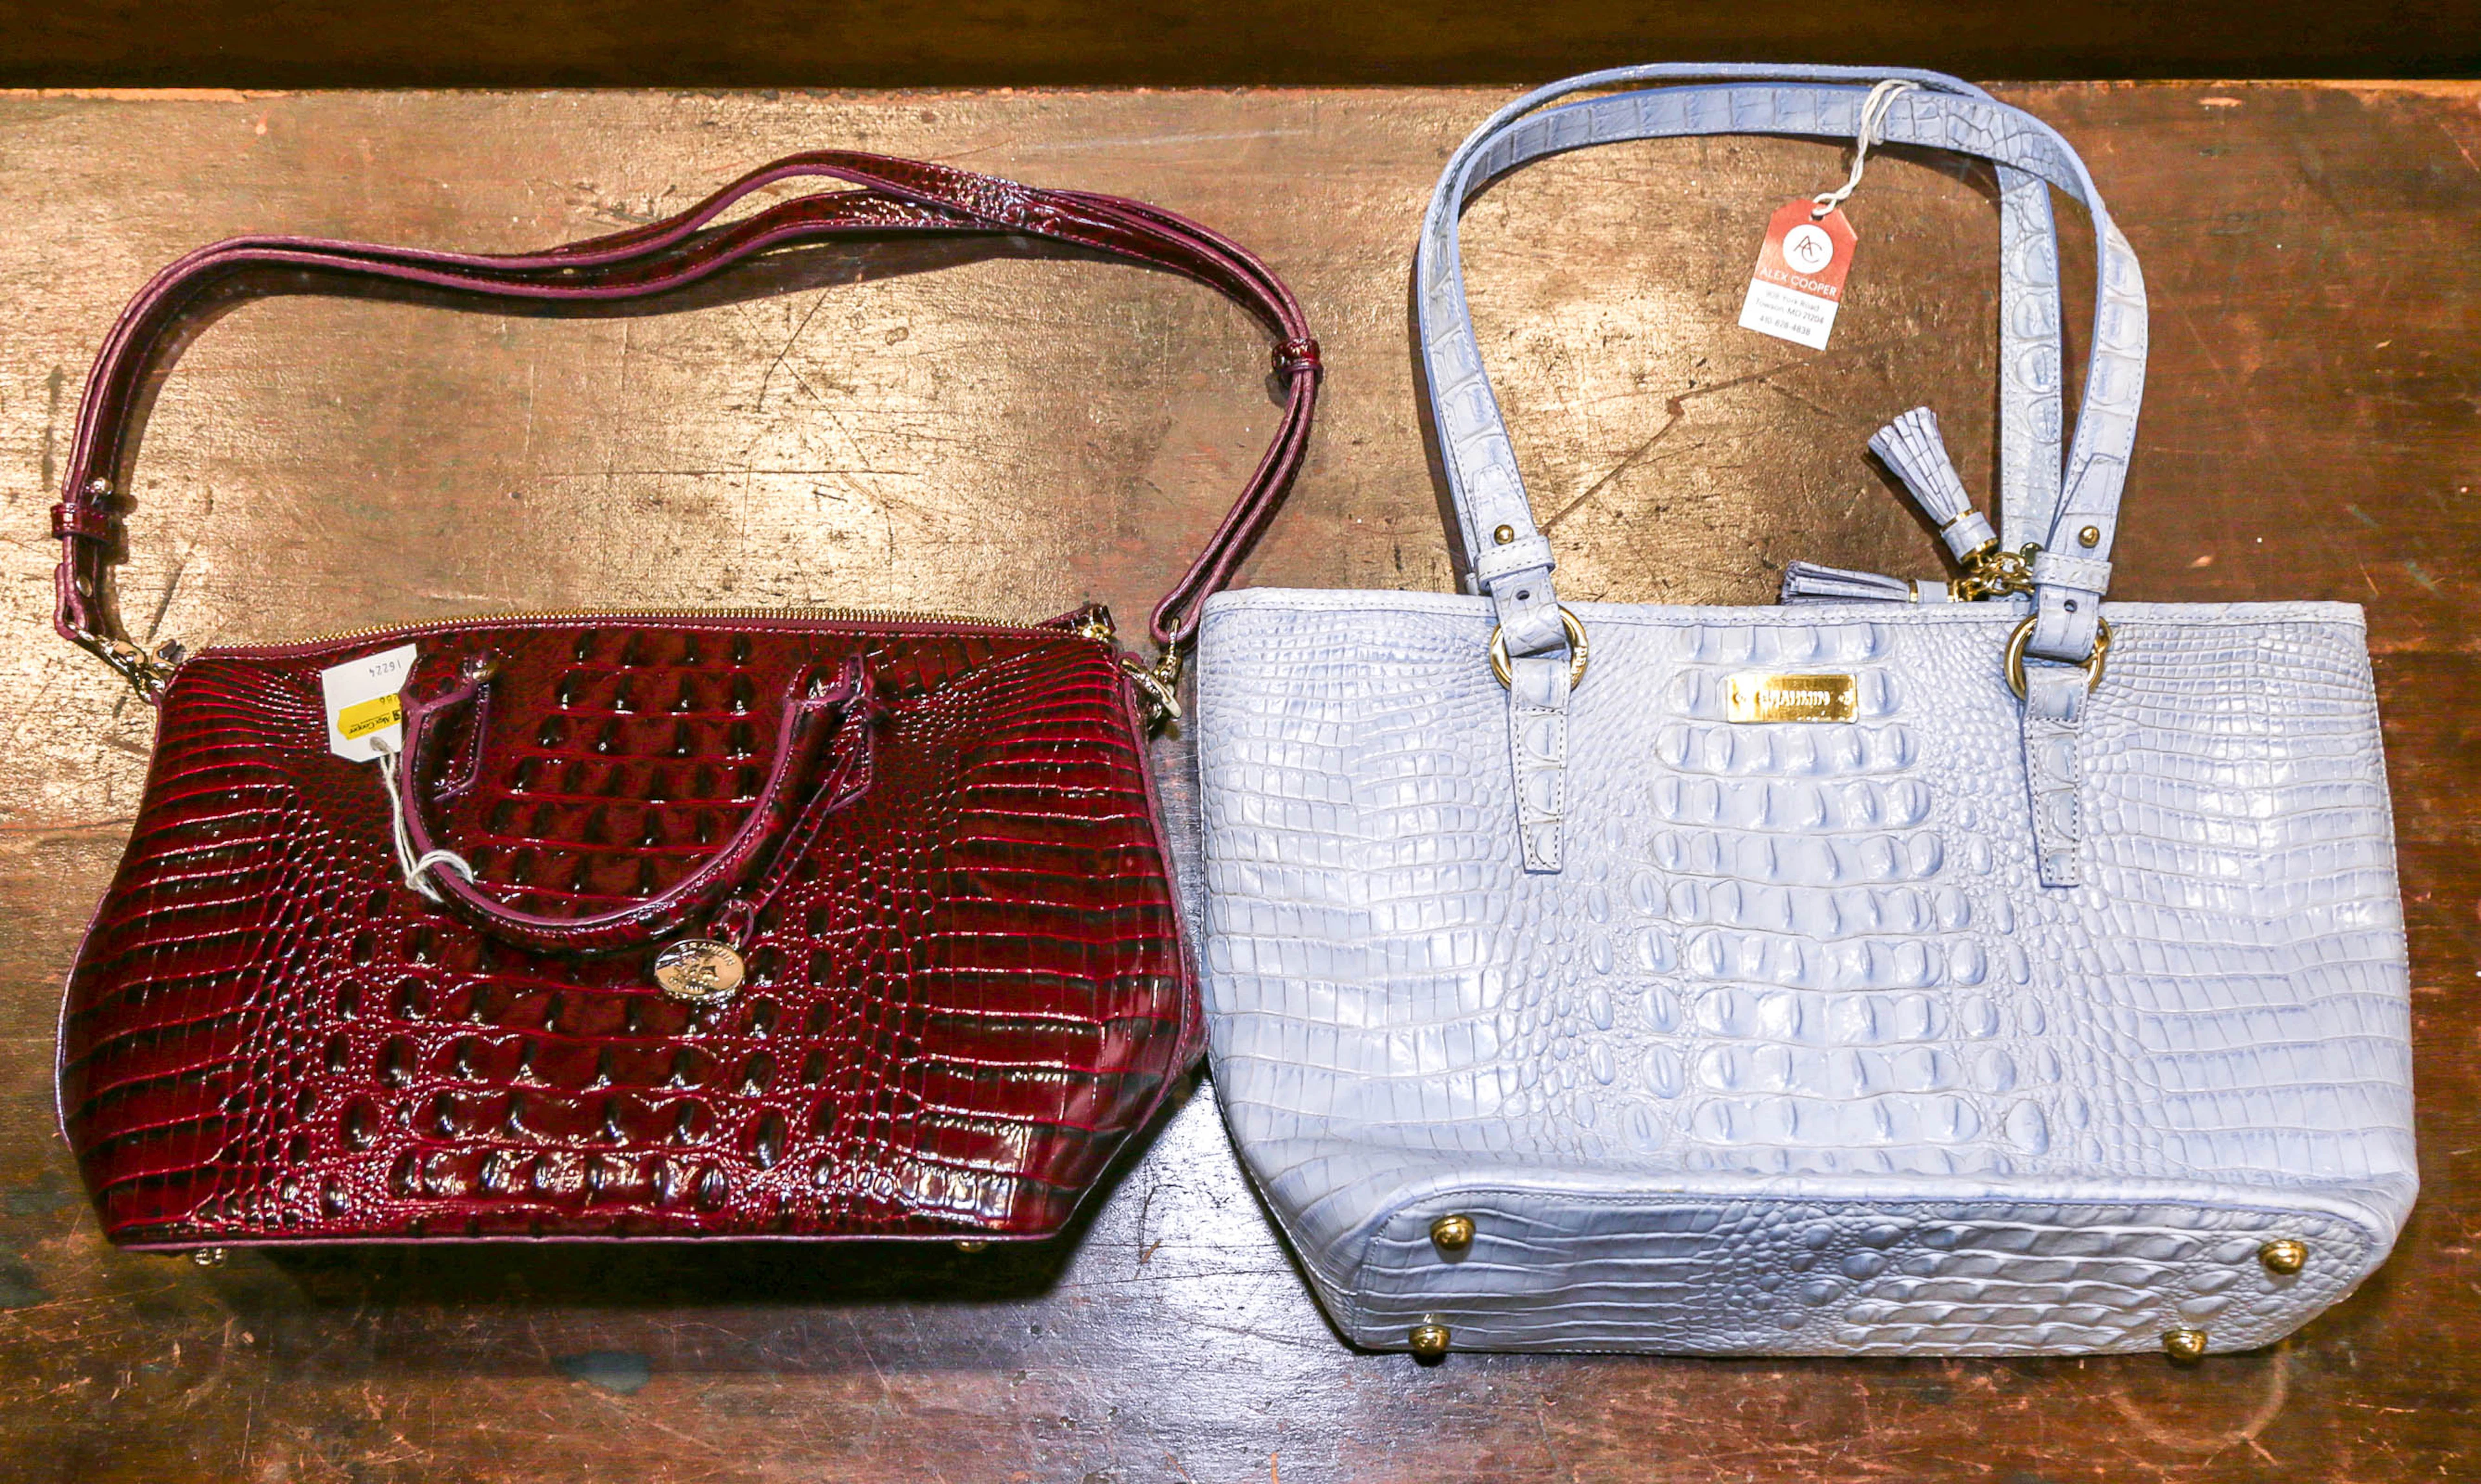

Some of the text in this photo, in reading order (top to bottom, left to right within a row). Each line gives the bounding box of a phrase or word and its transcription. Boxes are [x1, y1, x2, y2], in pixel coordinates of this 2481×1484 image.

[1759, 267, 1837, 297] ALEX COOPER
[1800, 300, 1820, 312] Road
[1787, 307, 1802, 317] MD
[1803, 313, 1825, 324] 21204
[369, 660, 401, 677] 16224
[349, 721, 375, 734] Cooper
